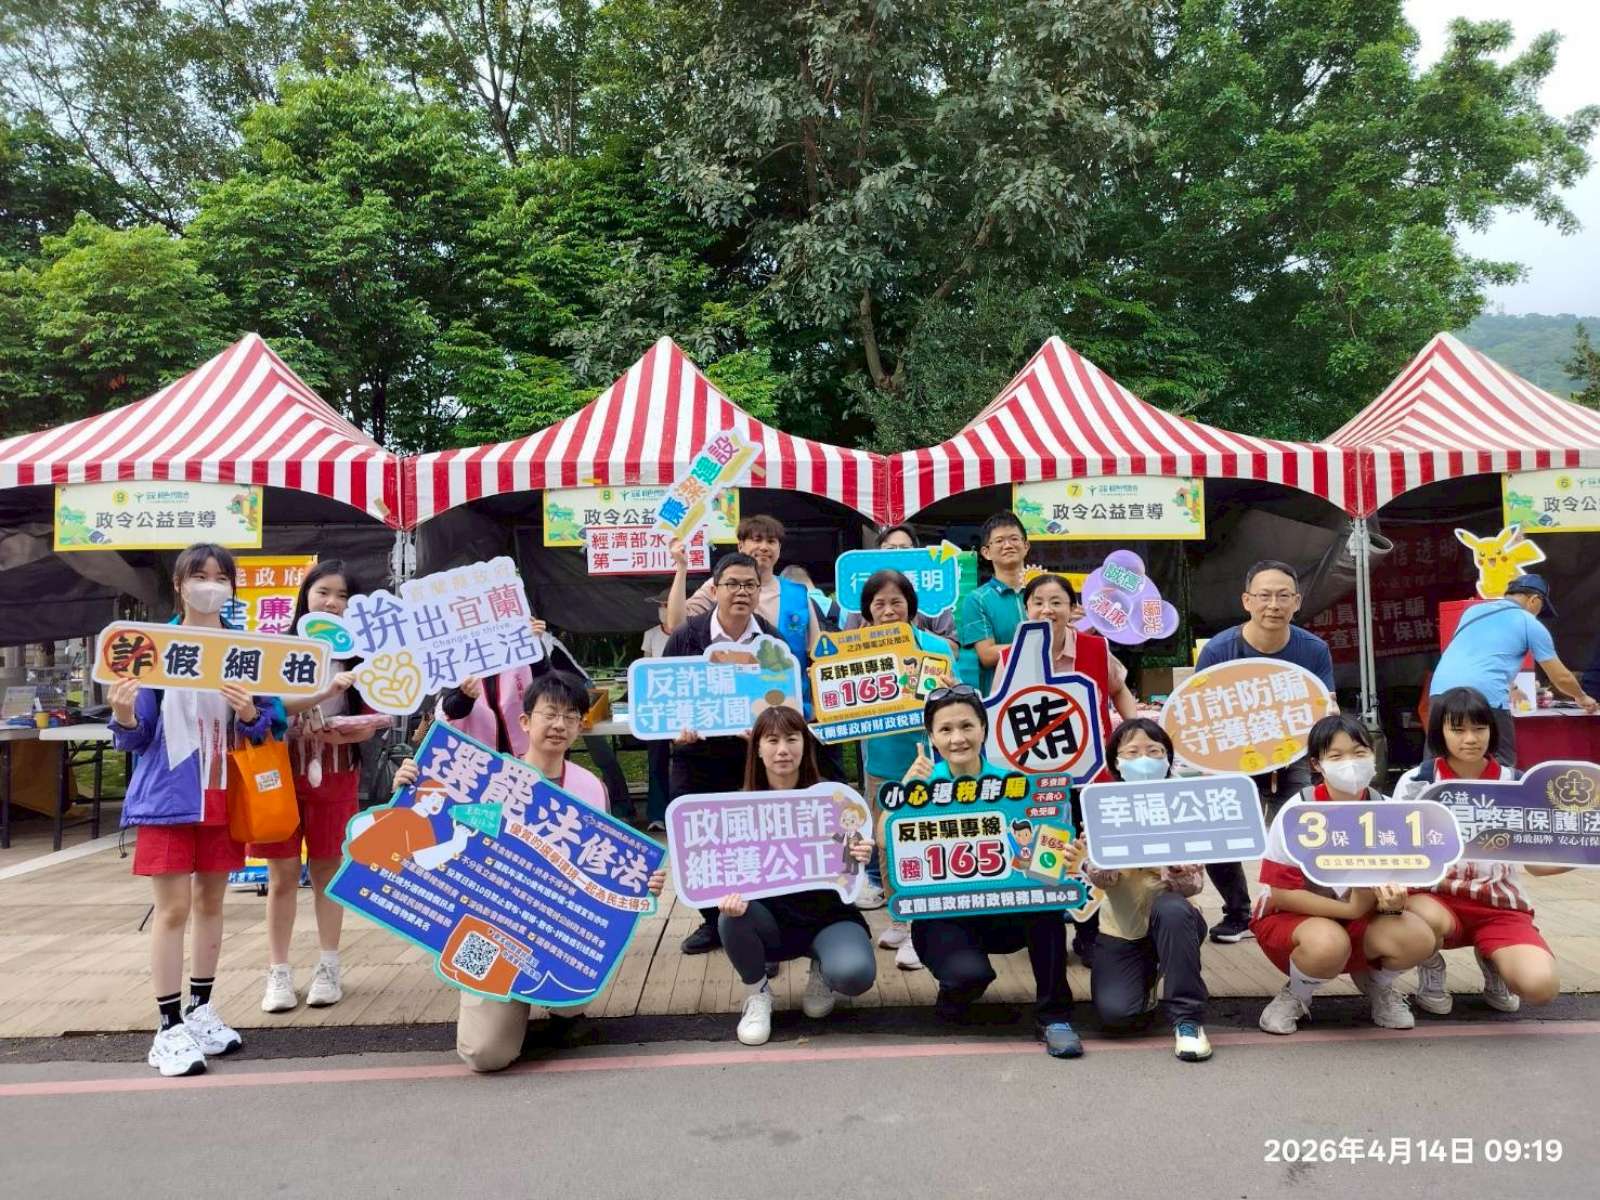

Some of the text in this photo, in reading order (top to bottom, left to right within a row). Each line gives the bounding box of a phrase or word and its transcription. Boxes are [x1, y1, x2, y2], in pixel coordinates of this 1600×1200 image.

[1072, 485, 1079, 496] 7
[95, 510, 217, 529] 政令公益宣導
[1052, 503, 1164, 520] 政令公益宣導
[591, 529, 704, 549] 經濟部水署
[592, 549, 705, 569] 第一河川署
[850, 569, 945, 593] 行明
[423, 625, 538, 689] 好生活
[820, 656, 895, 681] 反詐騙專線
[647, 664, 737, 698] 反詐騙
[1170, 670, 1310, 726] 打詐防騙
[637, 696, 752, 731] 守護家園
[815, 711, 925, 740] 蘭縣政府財政稅務
[1007, 695, 1079, 766] 賄
[1179, 705, 1315, 757] 守護錢包
[884, 776, 1027, 808] 小心退稅詐騙
[1439, 791, 1469, 804] 公益
[1097, 786, 1243, 829] 幸福公路
[682, 798, 834, 847] 政風阻詐
[898, 816, 1001, 843] 反詐騙專線
[685, 838, 839, 891] 維護公正
[899, 889, 1045, 915] 宜蘭縣政府財政稅務局
